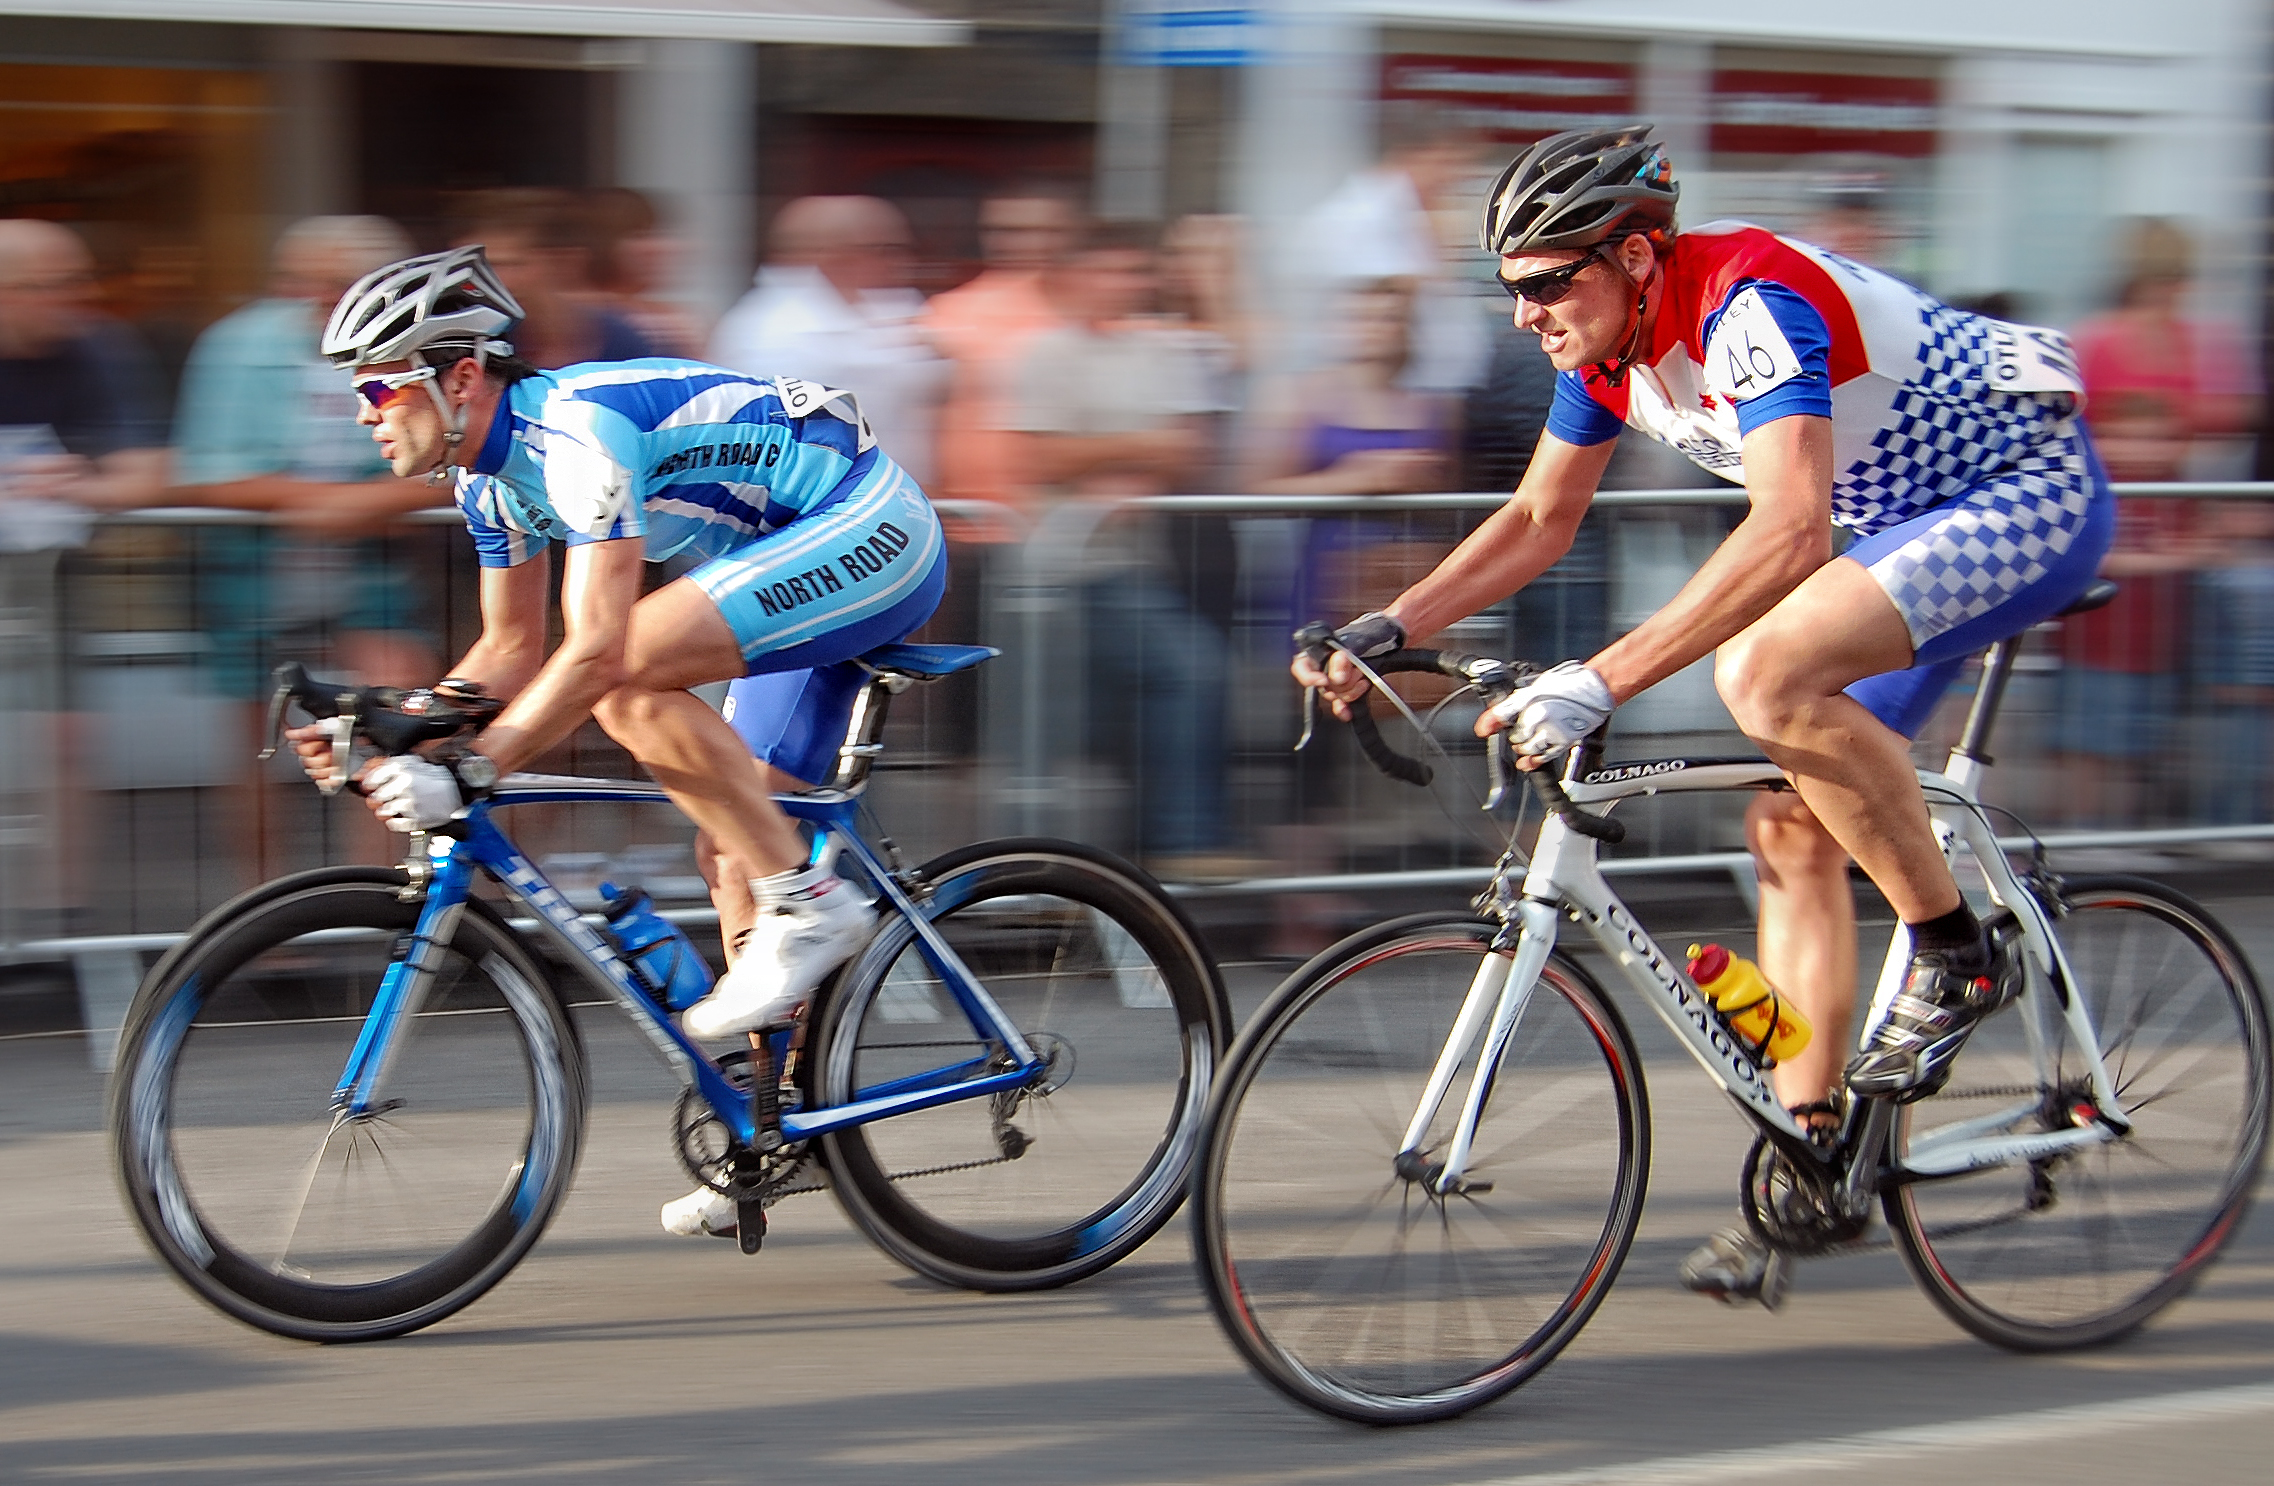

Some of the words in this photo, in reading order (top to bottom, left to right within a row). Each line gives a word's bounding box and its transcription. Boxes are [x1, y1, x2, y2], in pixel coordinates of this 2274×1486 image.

[1726, 329, 1776, 390] 46
[752, 563, 845, 618] NORTH
[836, 521, 910, 583] ROAD
[1583, 759, 1687, 785] COLNAGO
[1607, 901, 1756, 1083] COLNAGO
